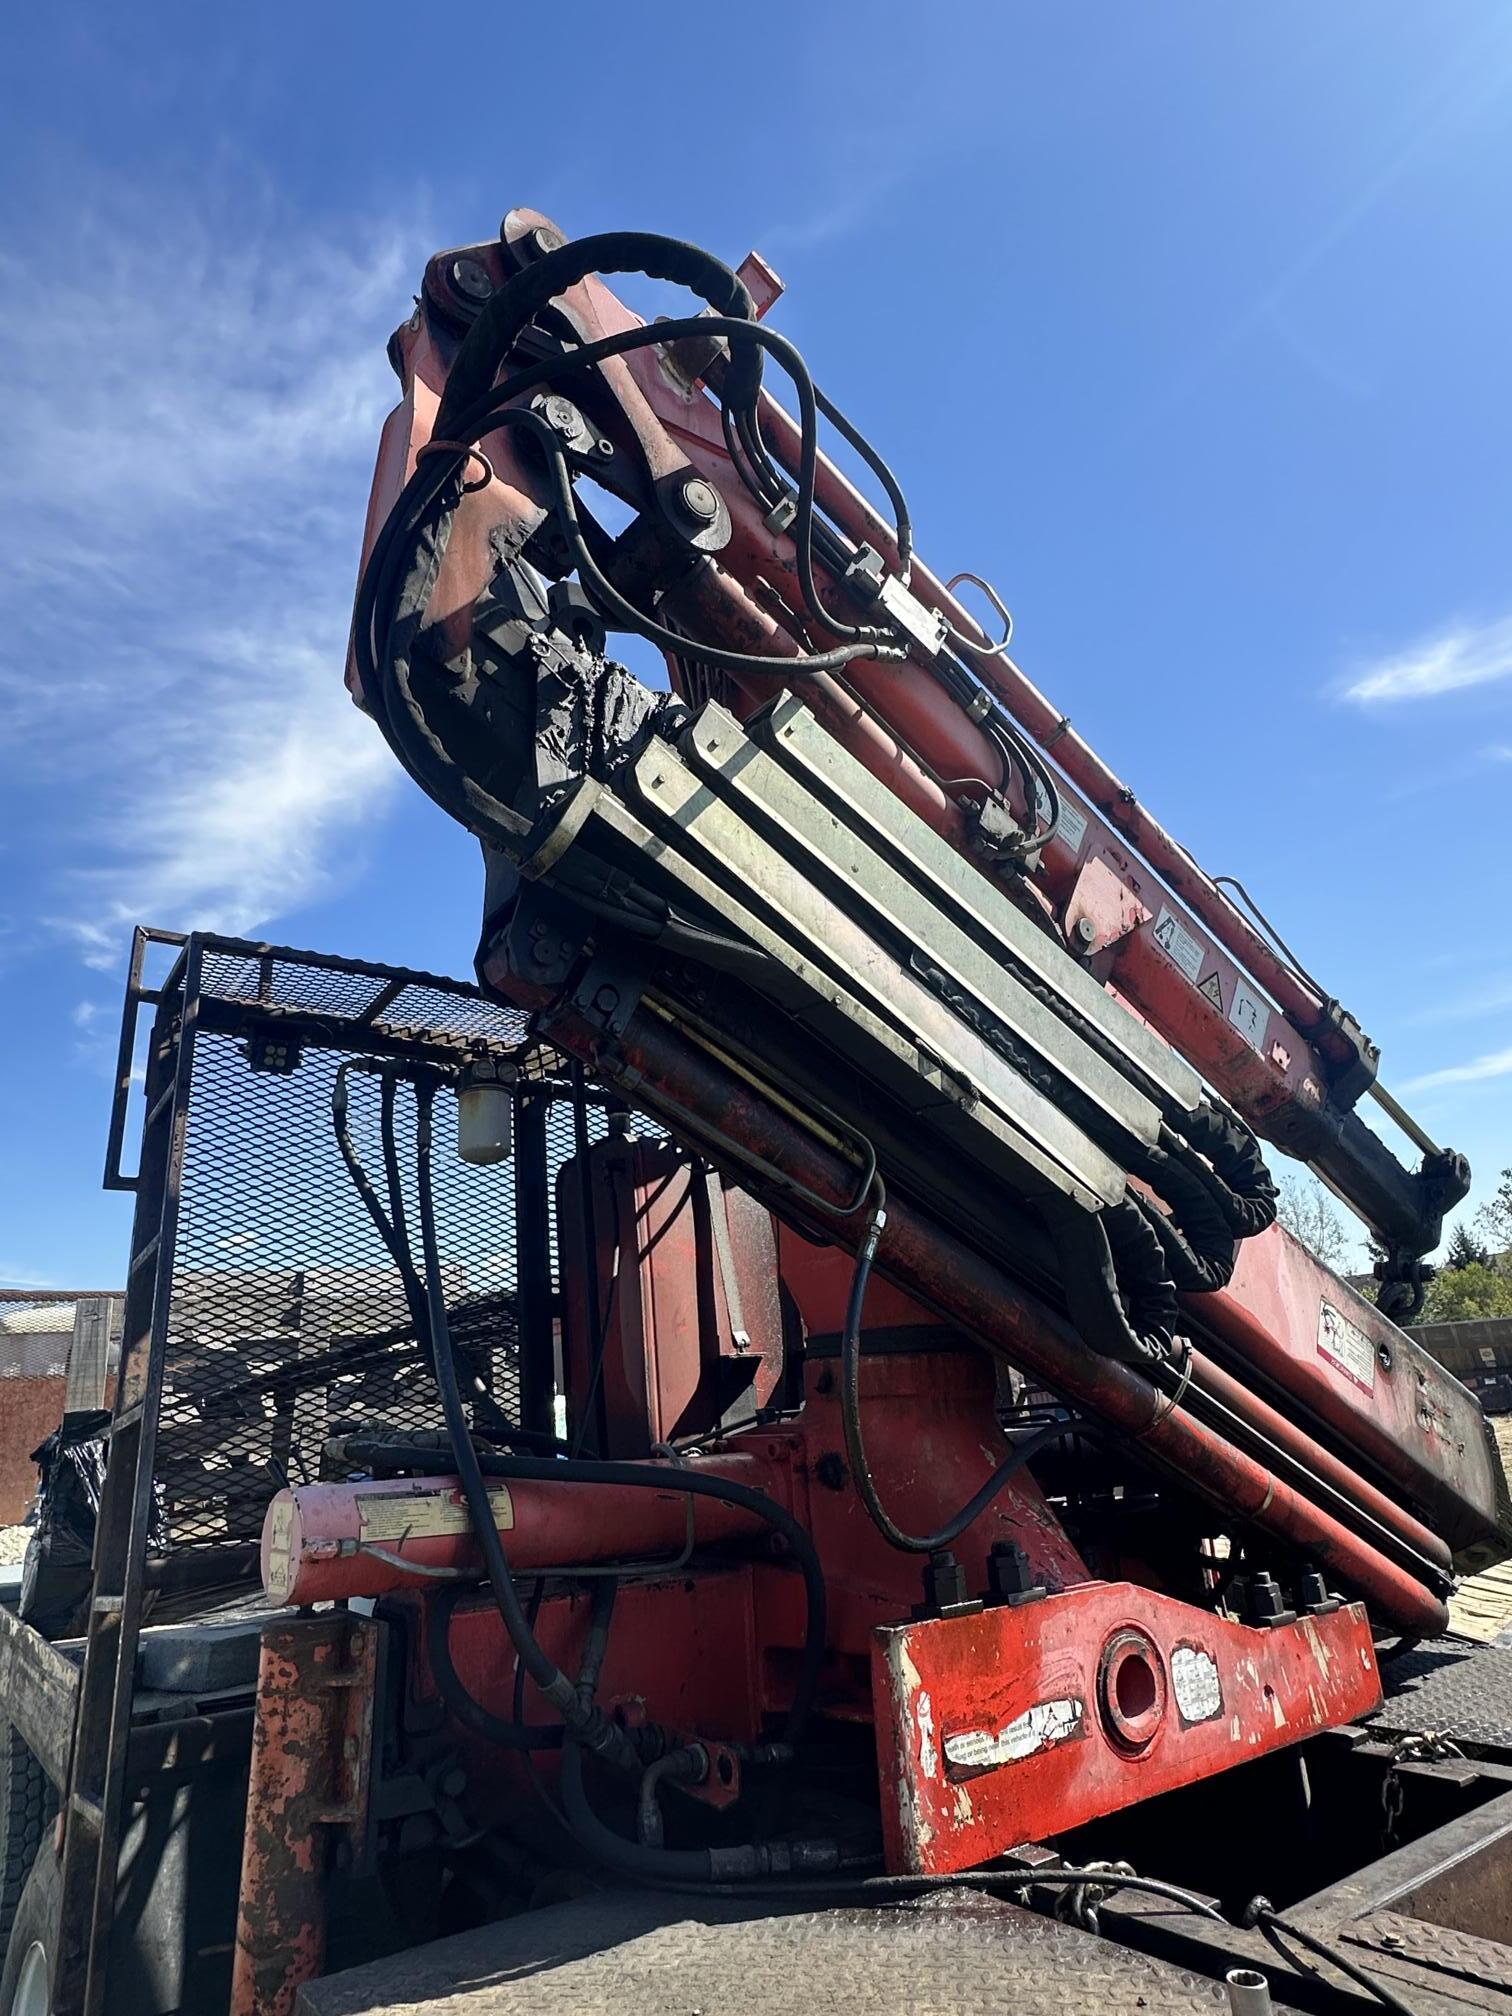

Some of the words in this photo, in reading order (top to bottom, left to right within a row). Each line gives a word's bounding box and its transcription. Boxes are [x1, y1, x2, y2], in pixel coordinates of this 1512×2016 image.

[966, 1737, 984, 1747] serious
[973, 1746, 988, 1755] being
[1000, 1739, 1010, 1747] this
[1010, 1733, 1028, 1744] vehicle
